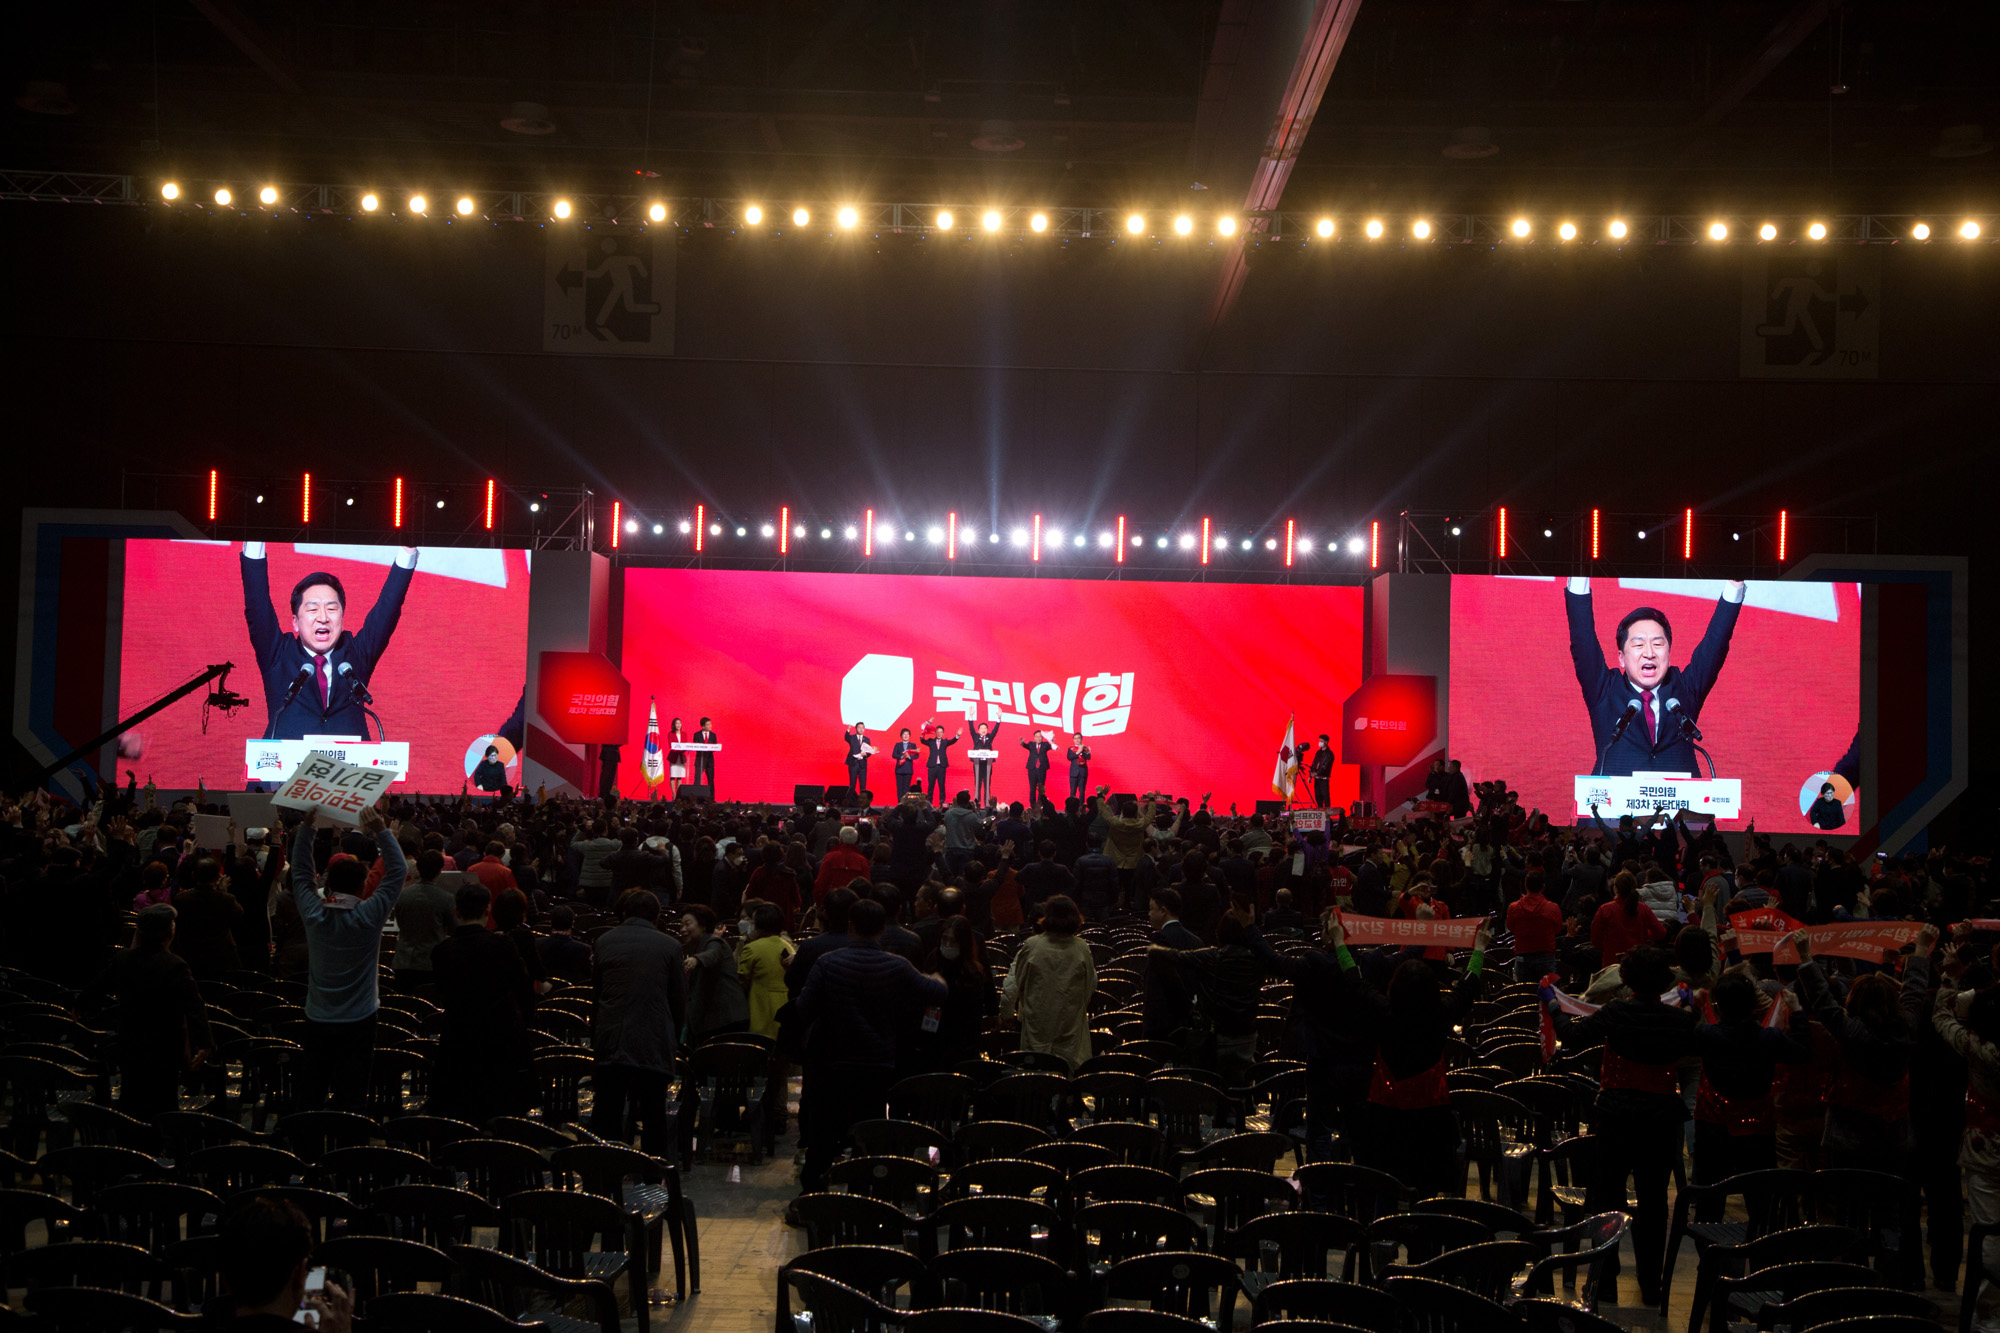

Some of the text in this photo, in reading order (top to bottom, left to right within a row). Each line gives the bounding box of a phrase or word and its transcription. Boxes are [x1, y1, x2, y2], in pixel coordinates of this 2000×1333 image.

[571, 693, 620, 707] 국민의힘
[933, 670, 1135, 737] 국민의힘
[1370, 719, 1407, 731] 국민의힘
[304, 758, 385, 792] 김기현
[284, 779, 366, 813] 국민의힘
[1639, 786, 1677, 798] 국민의힘
[1626, 799, 1690, 811] 제3차 전당대회
